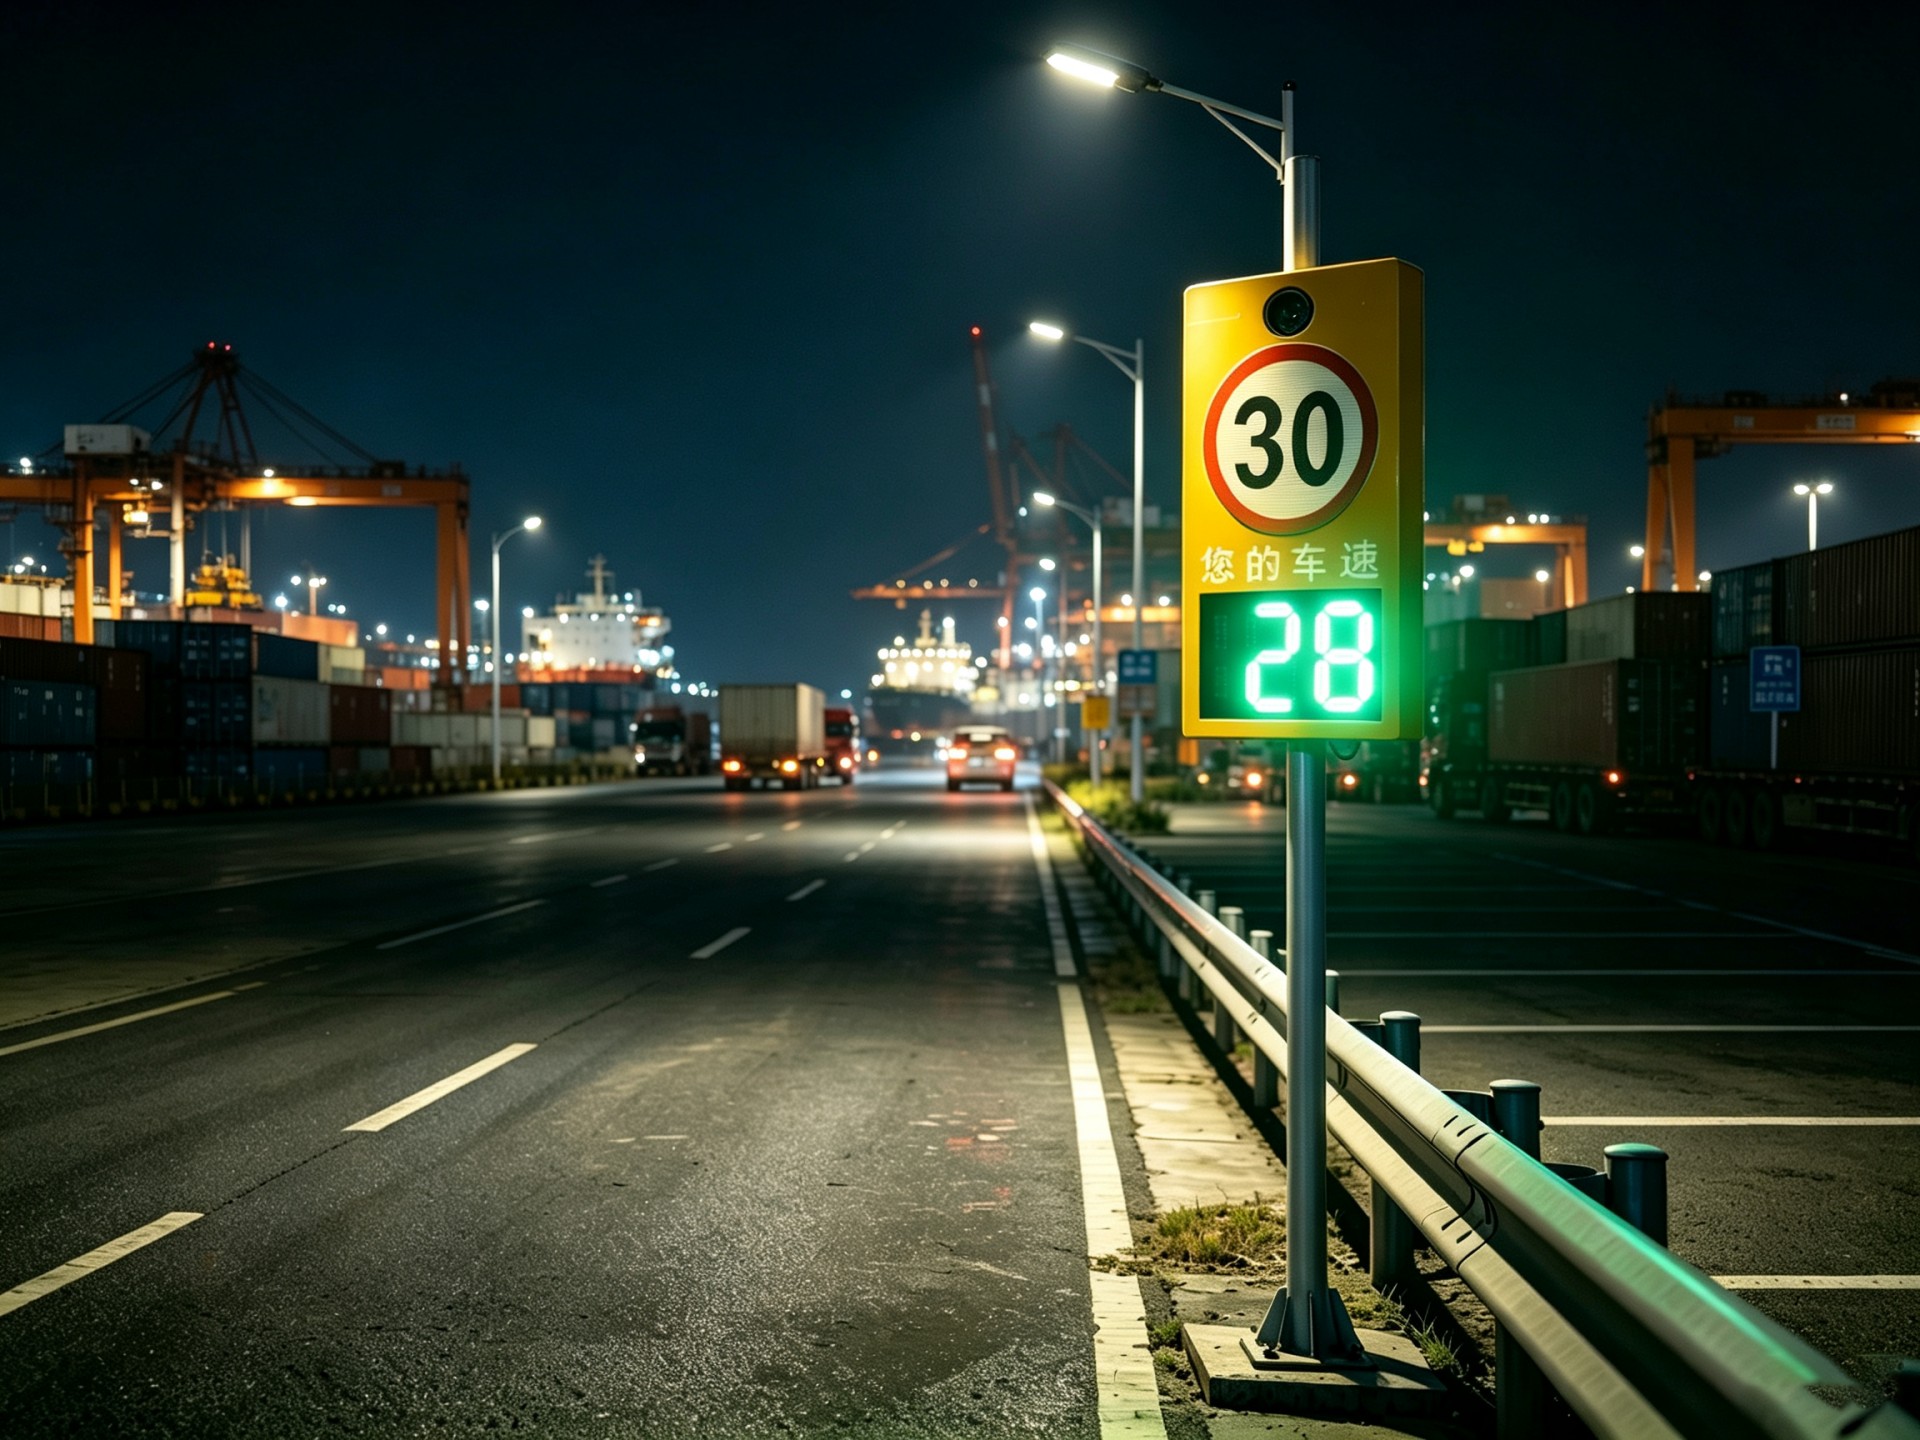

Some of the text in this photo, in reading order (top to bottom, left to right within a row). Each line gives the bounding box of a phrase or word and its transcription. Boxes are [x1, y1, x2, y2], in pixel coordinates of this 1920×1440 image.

[1234, 391, 1344, 489] 30
[1200, 539, 1379, 584] 您的车速
[1245, 600, 1374, 713] 28
